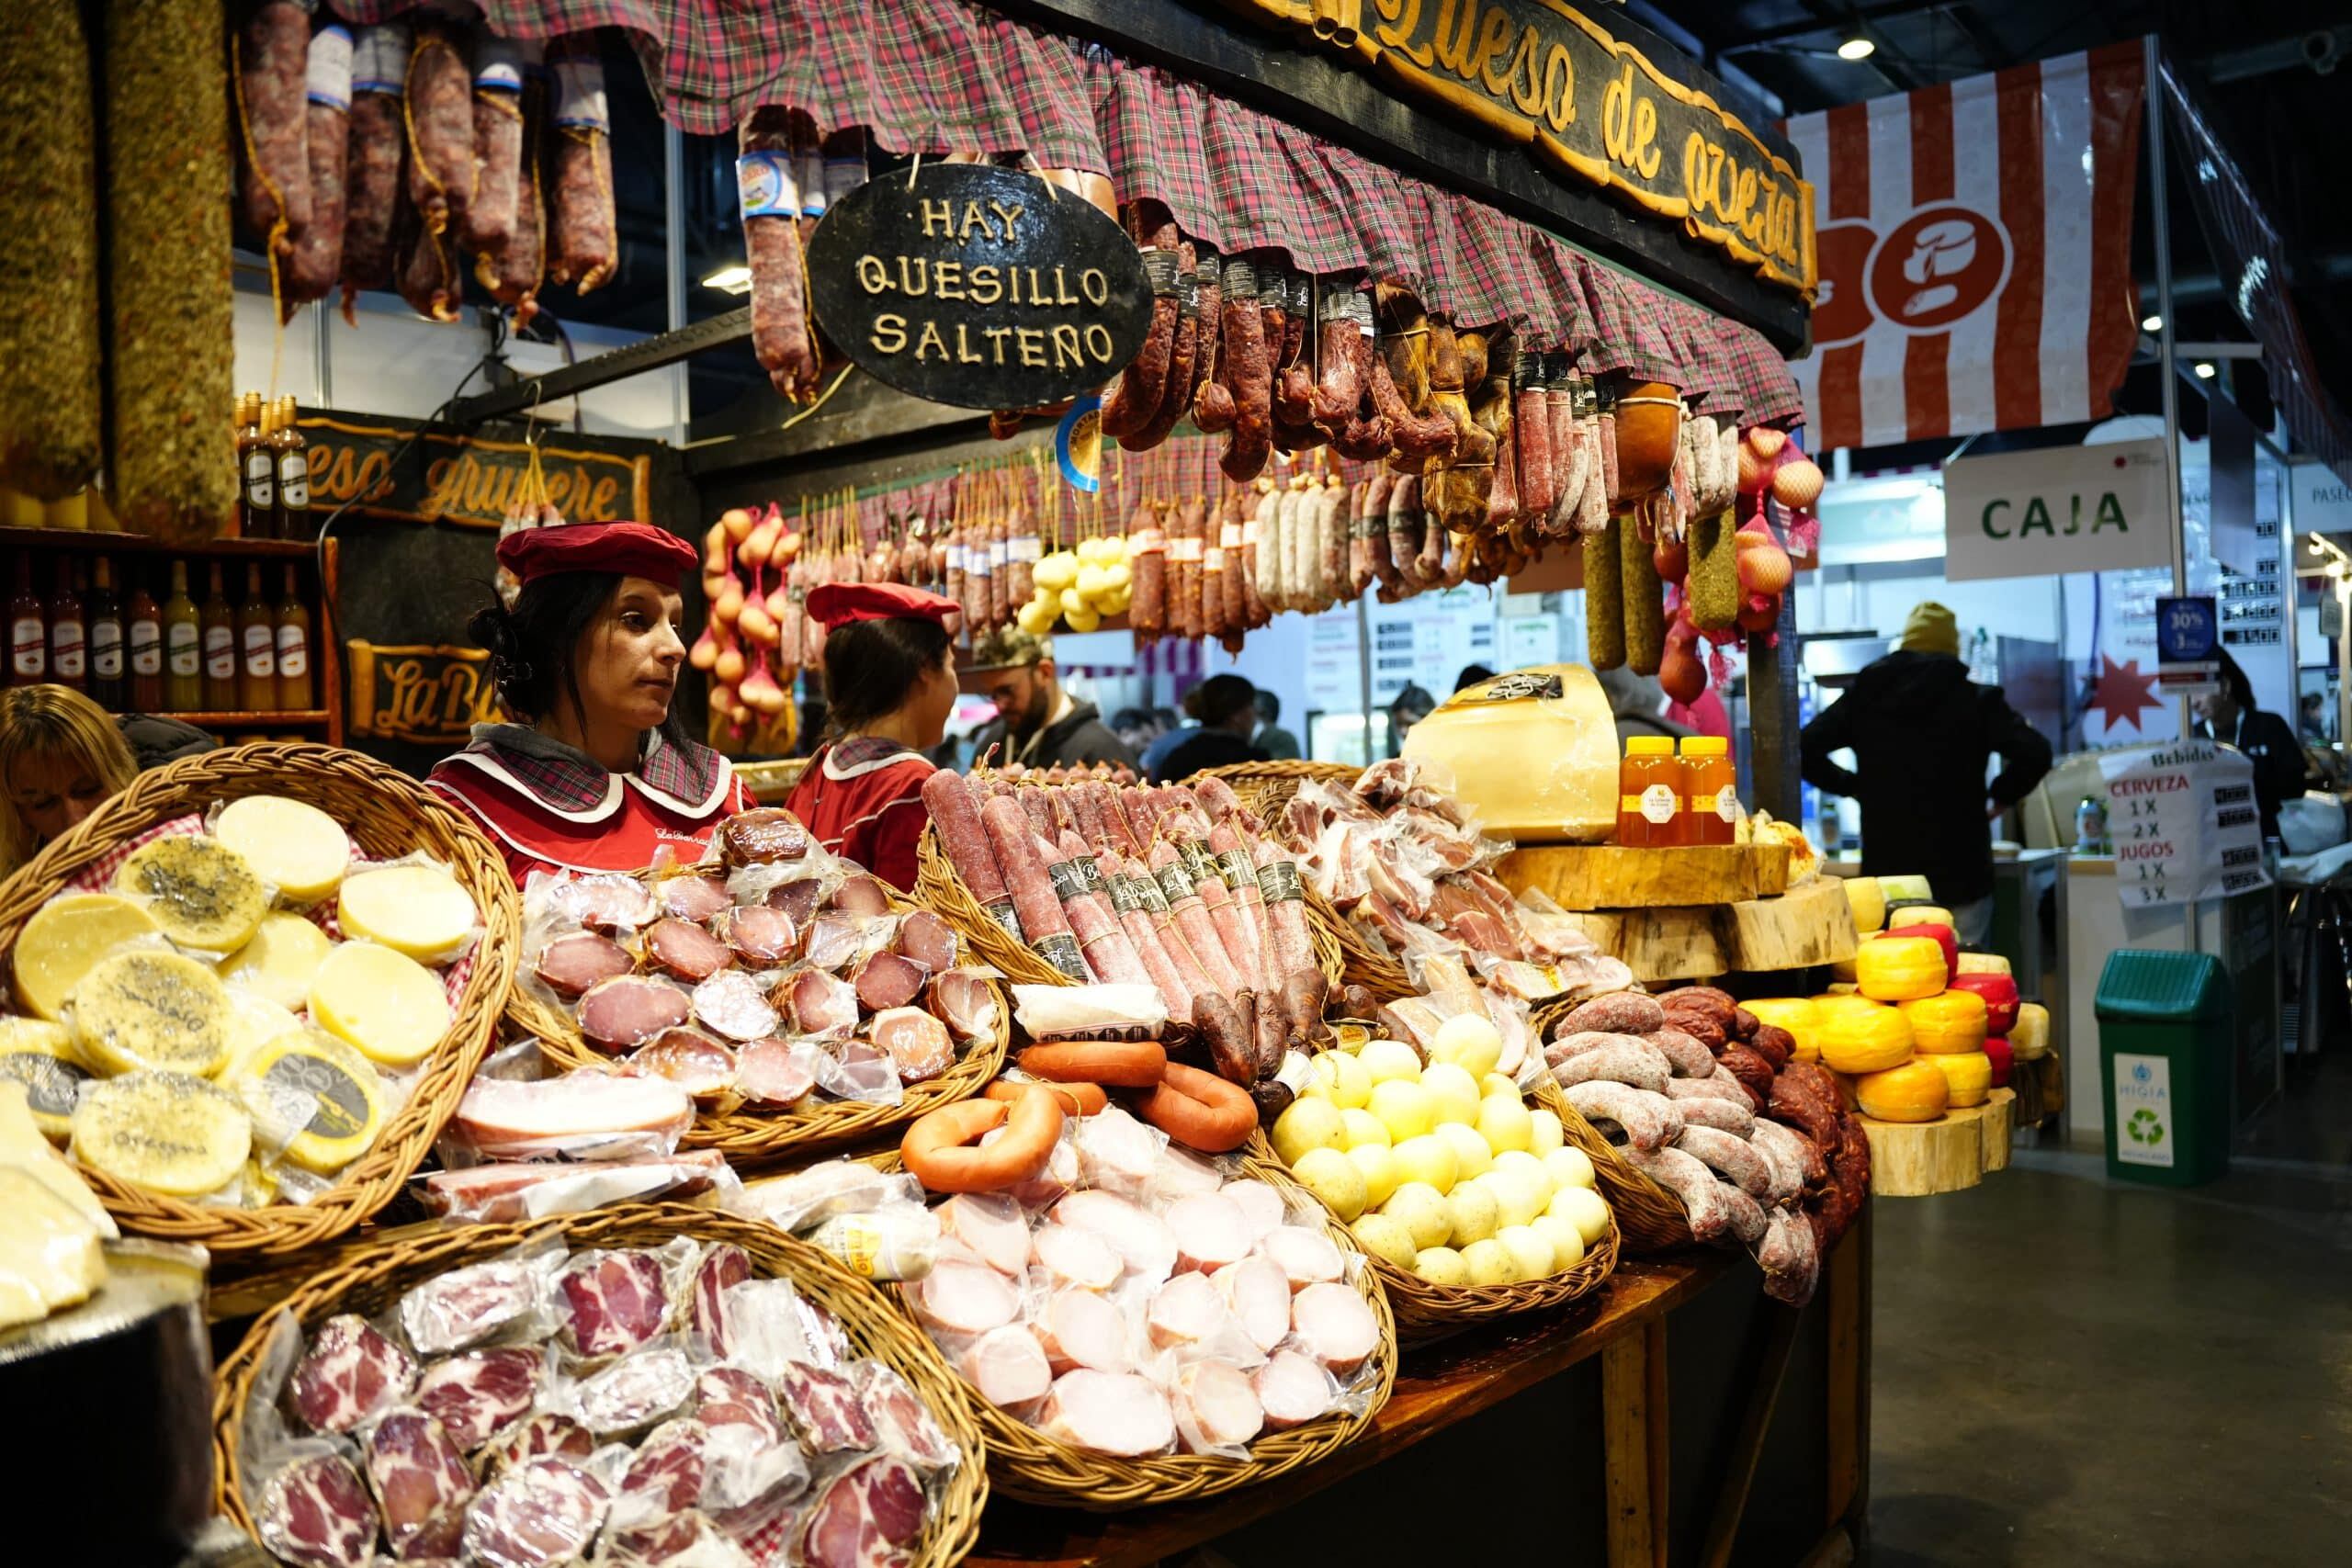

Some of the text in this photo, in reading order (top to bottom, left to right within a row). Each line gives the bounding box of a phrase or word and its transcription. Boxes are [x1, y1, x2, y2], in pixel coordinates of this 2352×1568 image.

[1601, 62, 1661, 180] de
[1684, 131, 1798, 268] oveja
[920, 198, 1024, 240] HAY
[858, 254, 1108, 307] QUESILLO
[1982, 491, 2129, 540] CAJA
[375, 660, 440, 731] La
[2151, 747, 2215, 768] Bebidas
[2110, 774, 2189, 797] CERVEZA
[2131, 798, 2157, 817] 1 X
[2133, 822, 2159, 840] 2 X
[2120, 841, 2175, 863] JUGOS
[2139, 862, 2165, 880] 1 X
[2155, 886, 2166, 901] X
